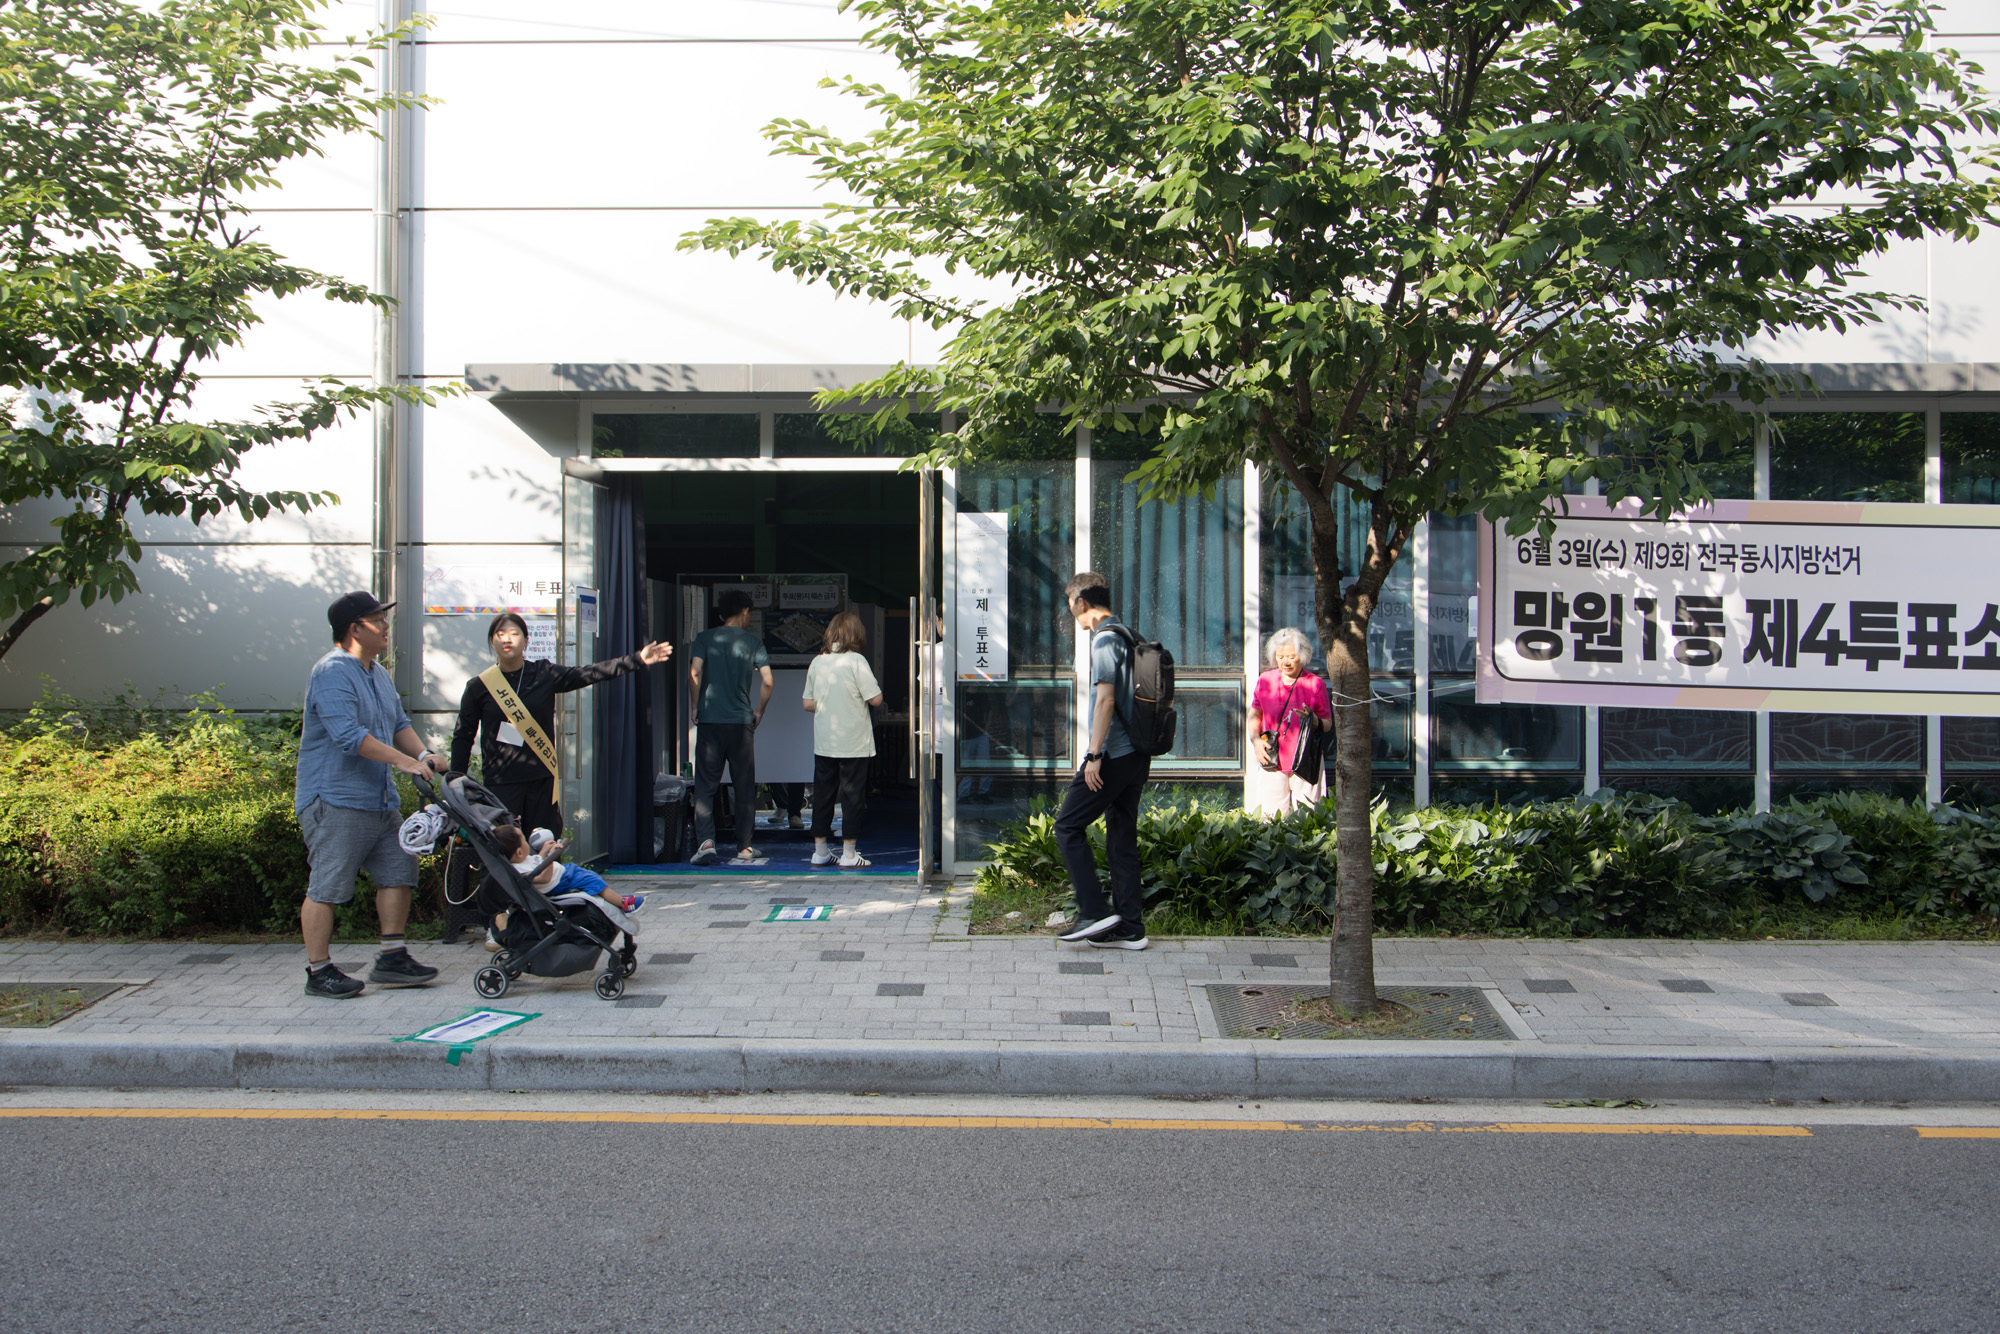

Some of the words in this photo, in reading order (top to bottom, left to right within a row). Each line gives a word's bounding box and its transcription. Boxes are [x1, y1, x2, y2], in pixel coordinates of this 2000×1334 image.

[1517, 538, 1552, 567] 6월
[1558, 539, 1627, 570] 3일(수)
[1634, 541, 1690, 571] 제9회
[1697, 543, 1861, 576] 전국동시지방선거
[1514, 590, 1727, 667] 망원1동
[1743, 598, 2000, 672] 제4투표소
[496, 689, 525, 722] 노약자
